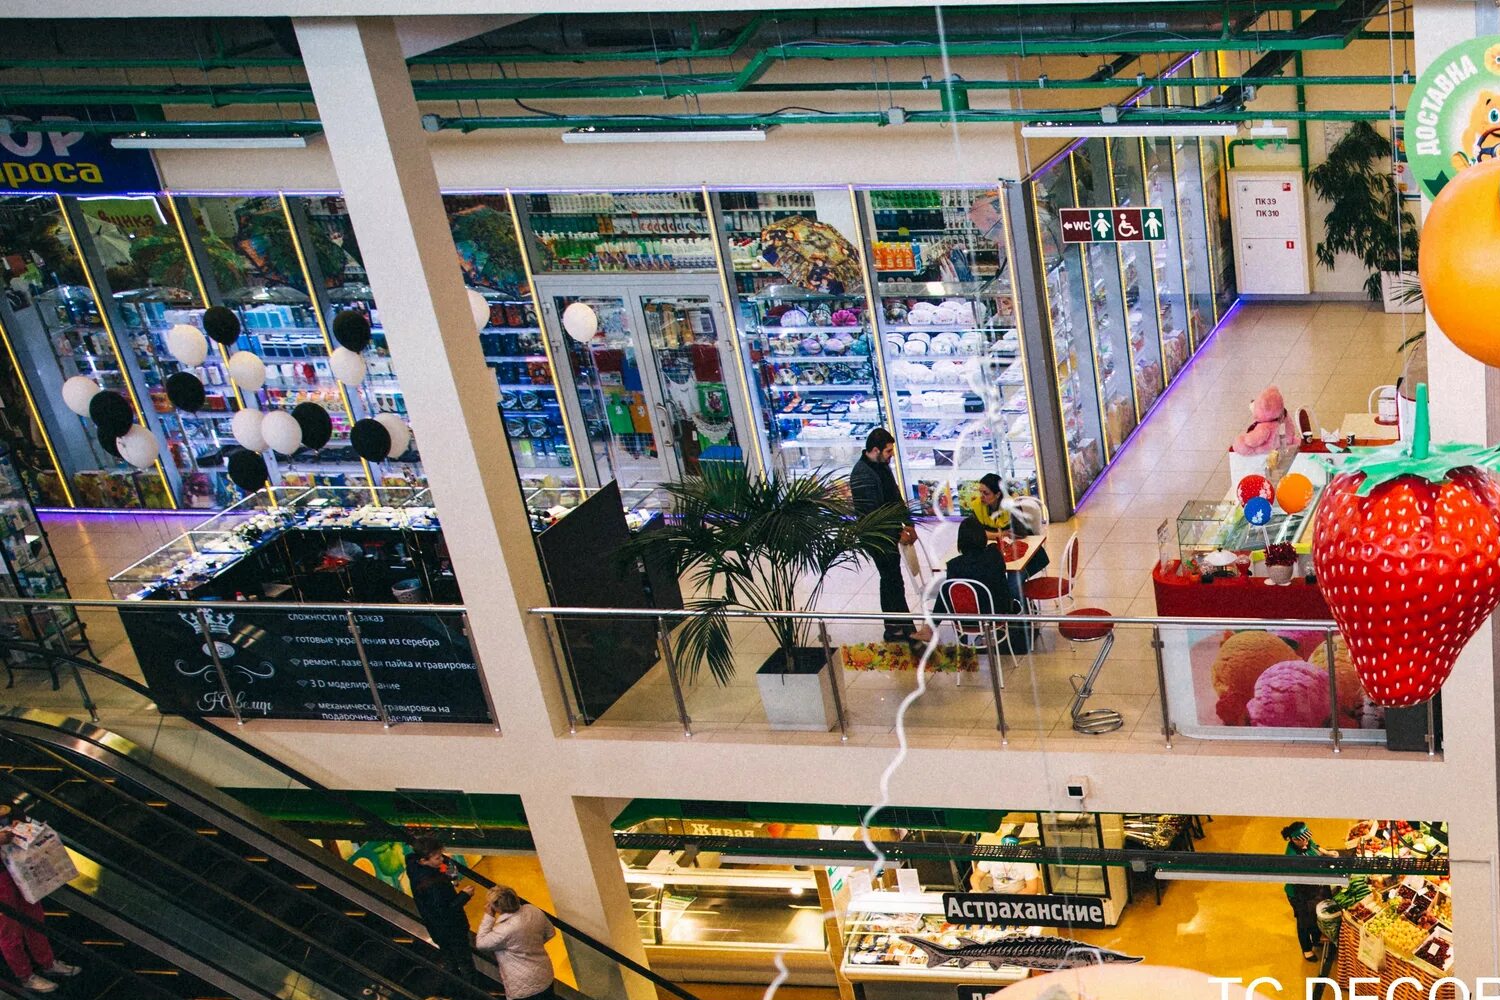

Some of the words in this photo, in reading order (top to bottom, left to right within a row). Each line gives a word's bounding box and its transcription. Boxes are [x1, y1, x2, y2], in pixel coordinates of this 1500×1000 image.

[1415, 54, 1478, 156] ДОСТАВКА
[1073, 221, 1091, 231] WC
[335, 637, 387, 647] украения
[402, 638, 440, 648] серебра
[690, 823, 755, 838] Живая
[946, 897, 1102, 923] Астраханские
